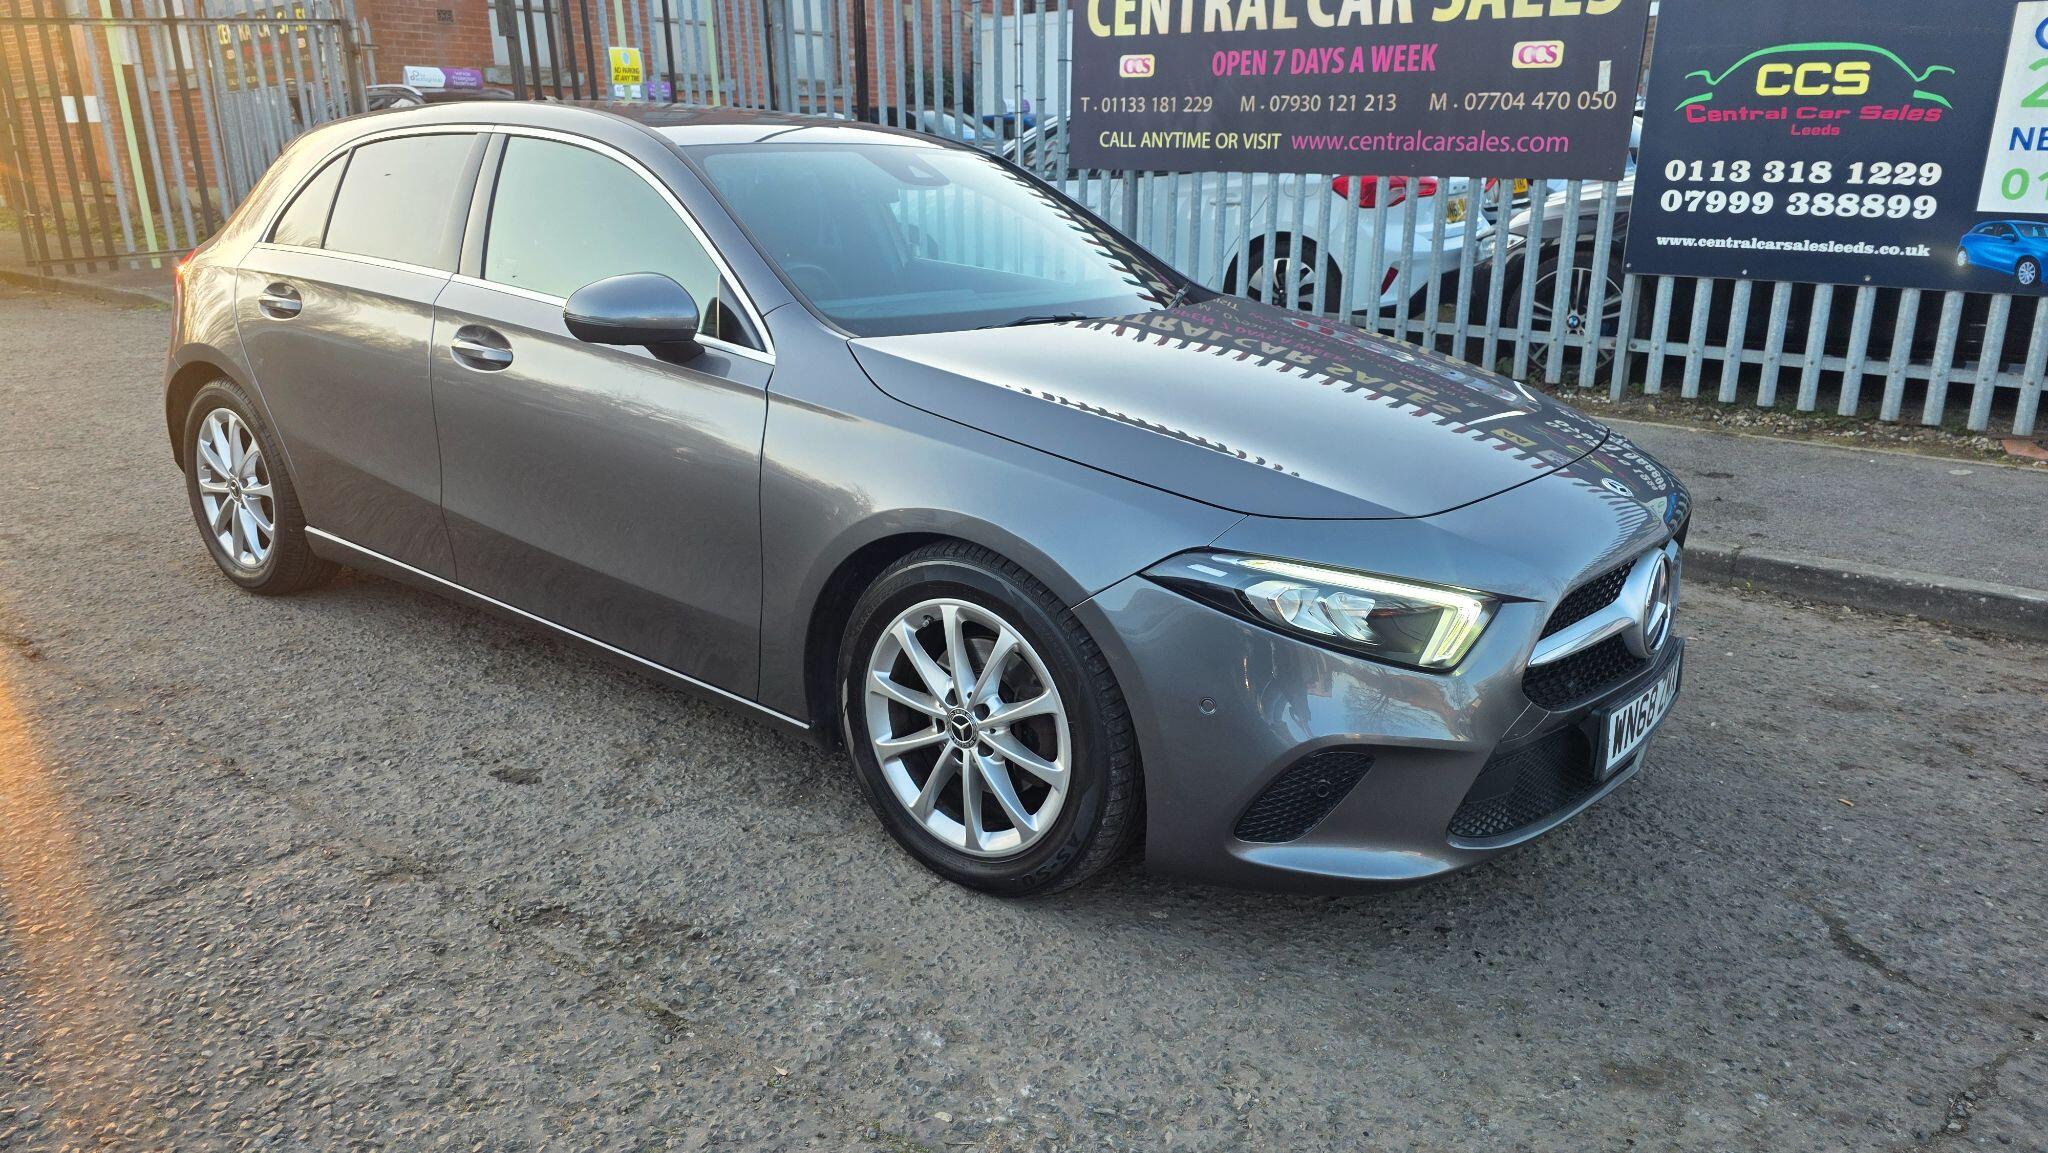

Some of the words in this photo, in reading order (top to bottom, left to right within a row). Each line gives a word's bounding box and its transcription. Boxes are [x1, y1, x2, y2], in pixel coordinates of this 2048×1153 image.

[615, 66, 621, 74] NO
[1212, 50, 1267, 77] OPEN
[1273, 50, 1285, 75] 7
[1291, 47, 1345, 75] DAYS
[1350, 46, 1364, 73] A
[1371, 43, 1438, 73] WEEK
[1756, 61, 1871, 96] CCS
[1080, 96, 1090, 112] T
[1101, 96, 1146, 113] 01133
[1152, 97, 1177, 112] 181
[1183, 97, 1212, 113] 229
[1240, 95, 1256, 112] M
[1269, 95, 1321, 112] 07930
[1328, 94, 1356, 112] 121
[1363, 93, 1397, 111] 213
[1429, 92, 1448, 111] M
[1464, 92, 1525, 111] 07704
[1531, 91, 1571, 110] 470
[1577, 91, 1617, 110] 050
[1686, 104, 1787, 123] Central
[1796, 106, 1850, 120] Car
[1859, 104, 1942, 122] Sales
[1790, 123, 1840, 136] Leeds
[1099, 131, 1136, 148] CALL
[1140, 131, 1211, 149] ANYTIME
[1215, 132, 1239, 150] OR
[1243, 133, 1282, 150] VISIT
[1291, 129, 1570, 153] www.centralcarsales.com
[1664, 159, 1751, 183] 0113
[1762, 160, 1832, 184] 318
[1847, 161, 1943, 186] 1229
[1660, 189, 1774, 215] 07999
[1786, 192, 1938, 220] 388899
[1656, 235, 1931, 257] www.centralcarsalesleeds.co.uk
[1612, 683, 1659, 759] WN68
